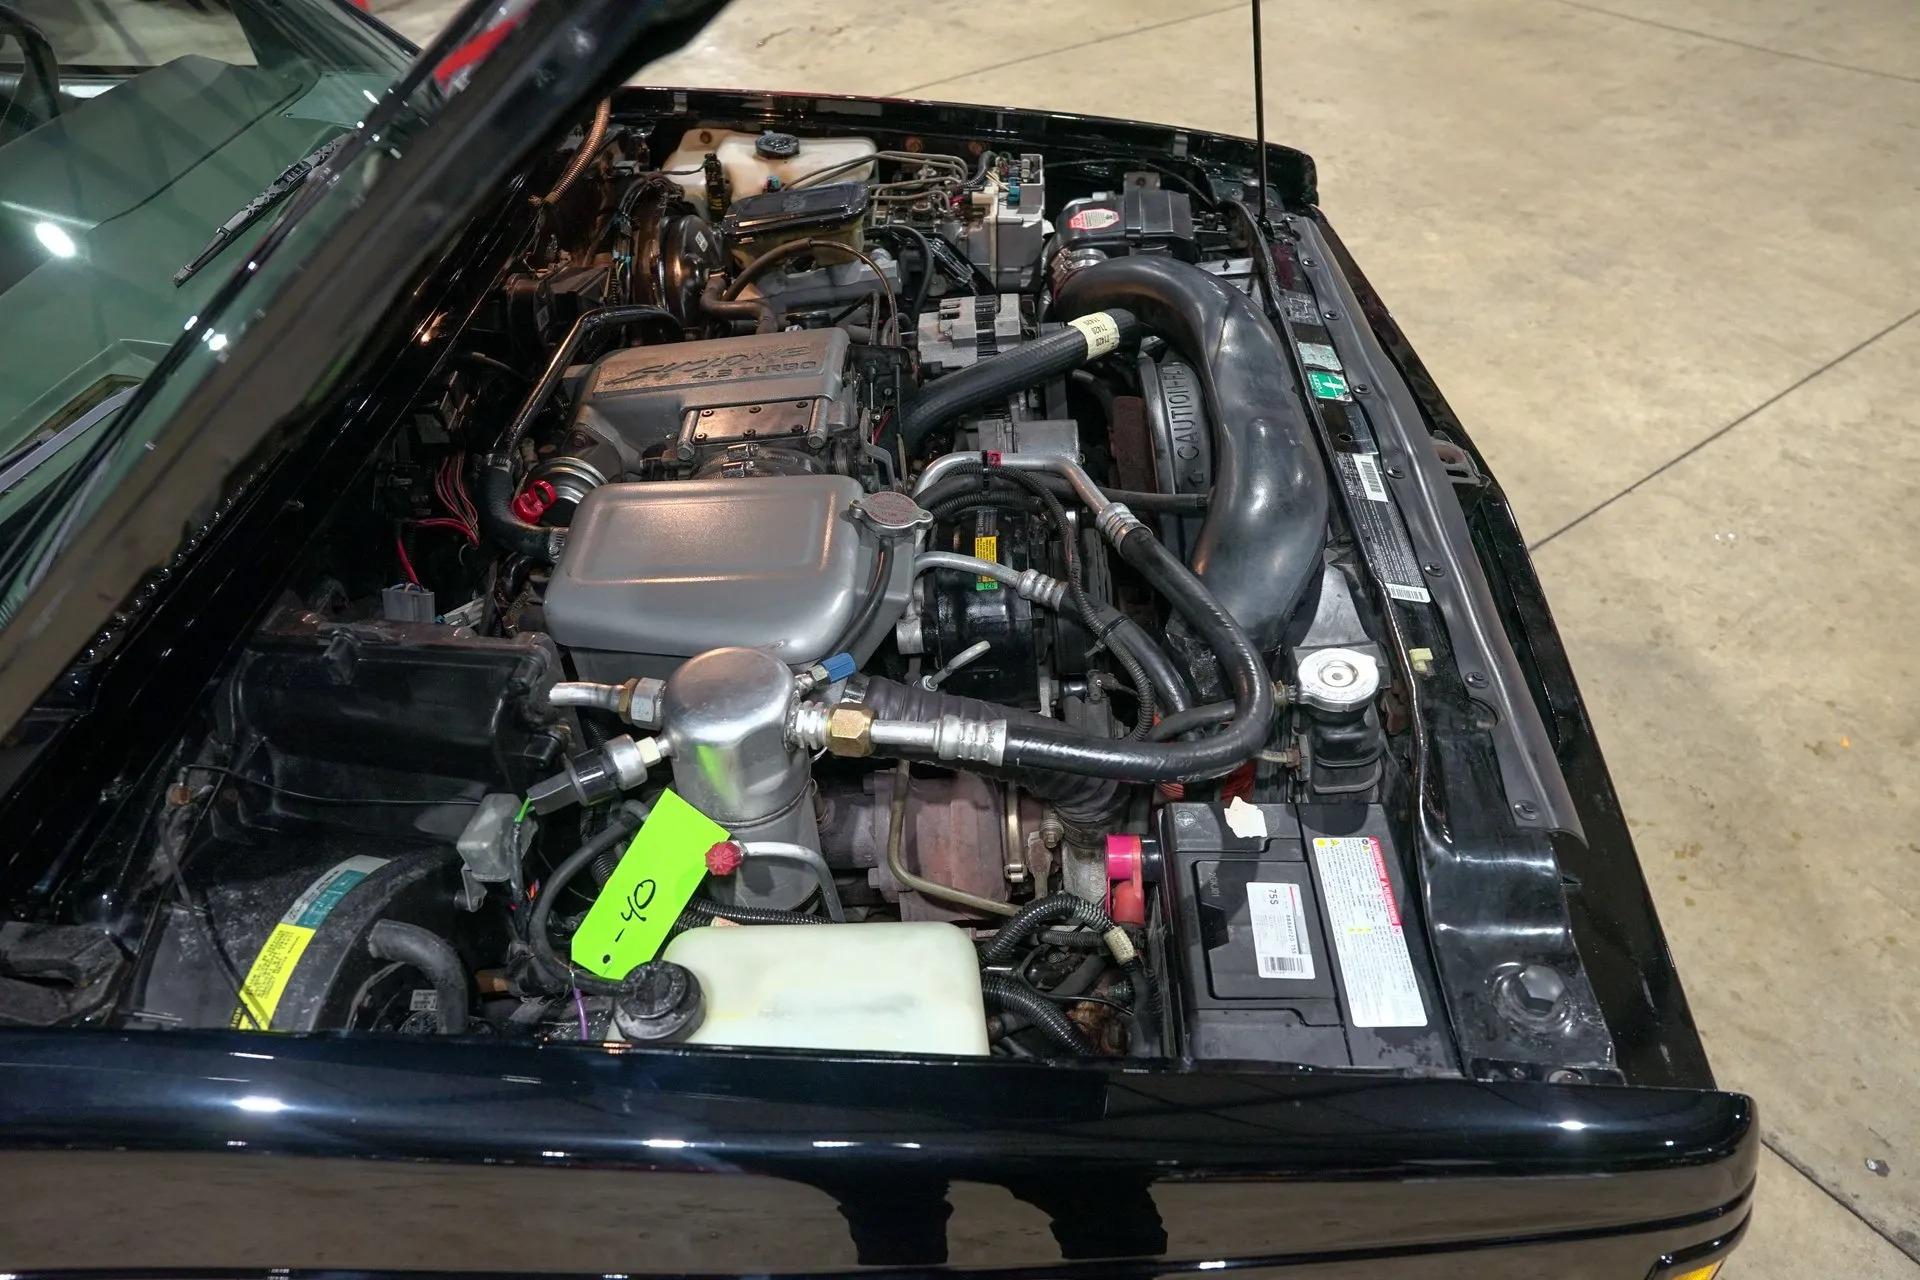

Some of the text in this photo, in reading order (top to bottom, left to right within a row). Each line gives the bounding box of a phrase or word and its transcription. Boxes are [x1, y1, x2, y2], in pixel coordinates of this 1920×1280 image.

[691, 360, 817, 380] 4.3 TURBO
[614, 878, 656, 943] -40
